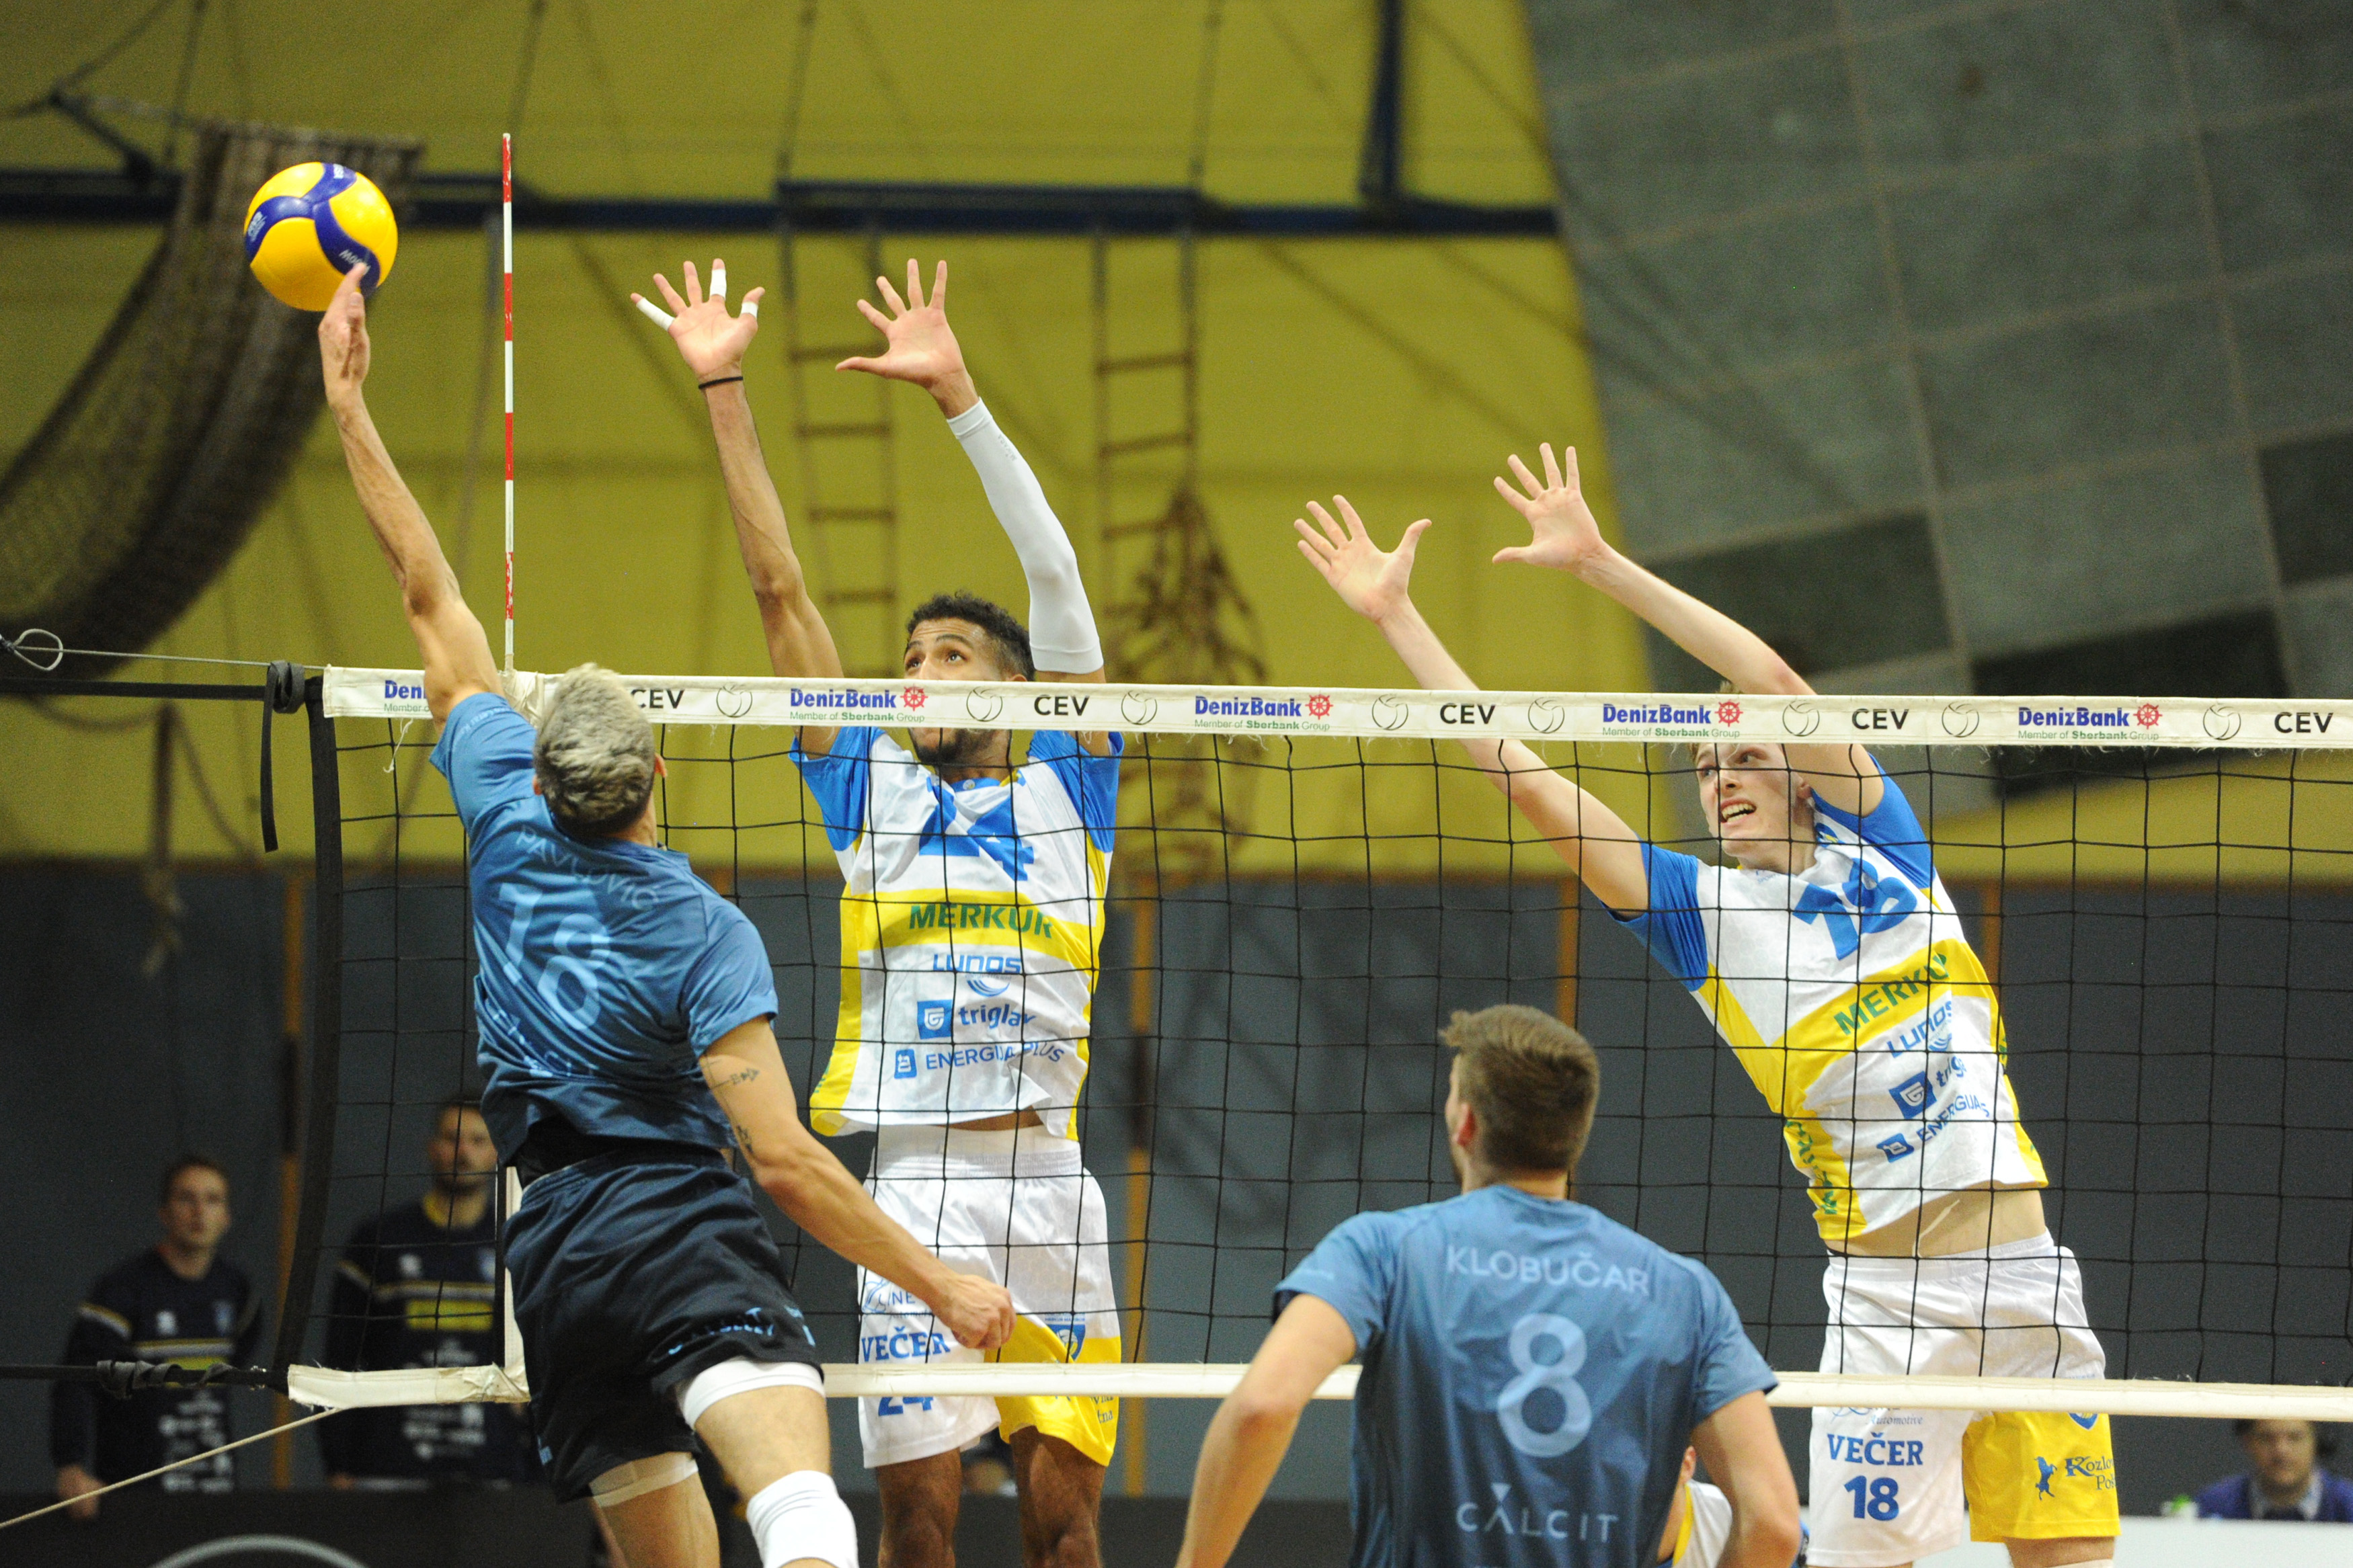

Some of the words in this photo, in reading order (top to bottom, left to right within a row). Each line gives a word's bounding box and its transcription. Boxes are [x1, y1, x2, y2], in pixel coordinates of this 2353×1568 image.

[384, 703, 421, 712] Member
[790, 688, 897, 708] DenizBank
[1034, 695, 1089, 717] CEV
[1195, 695, 1302, 716] DenizBank
[790, 711, 826, 720] Member
[830, 711, 839, 720] of
[841, 712, 894, 721] Sberbank
[896, 712, 925, 723] Group
[1440, 704, 1496, 725] CEV
[1603, 703, 1712, 724] DenizBank
[1851, 708, 1909, 731] CEV
[2018, 706, 2130, 727] DenizBank
[2274, 712, 2333, 734] CEV
[1194, 719, 1232, 728] Member
[1234, 720, 1243, 728] of
[1246, 720, 1300, 730] Sberbank
[1302, 721, 1330, 731] Group
[1602, 727, 1640, 736] Member
[1642, 727, 1652, 736] of
[1654, 728, 1709, 737] Sberbank
[1711, 729, 1740, 739] Group
[2018, 731, 2056, 739] Member
[2059, 731, 2069, 739] of
[2072, 731, 2127, 740] Sberbank
[2129, 731, 2159, 741] Group
[909, 904, 1053, 939] MERKUR
[1833, 952, 1949, 1036] MERKU
[958, 1003, 1037, 1029] triglav
[1447, 1245, 1650, 1295] KLOBUČAR
[861, 1325, 951, 1362] VEČER
[1497, 1313, 1593, 1458] 8
[1827, 1432, 1923, 1466] VEČER
[1843, 1475, 1899, 1522] 18
